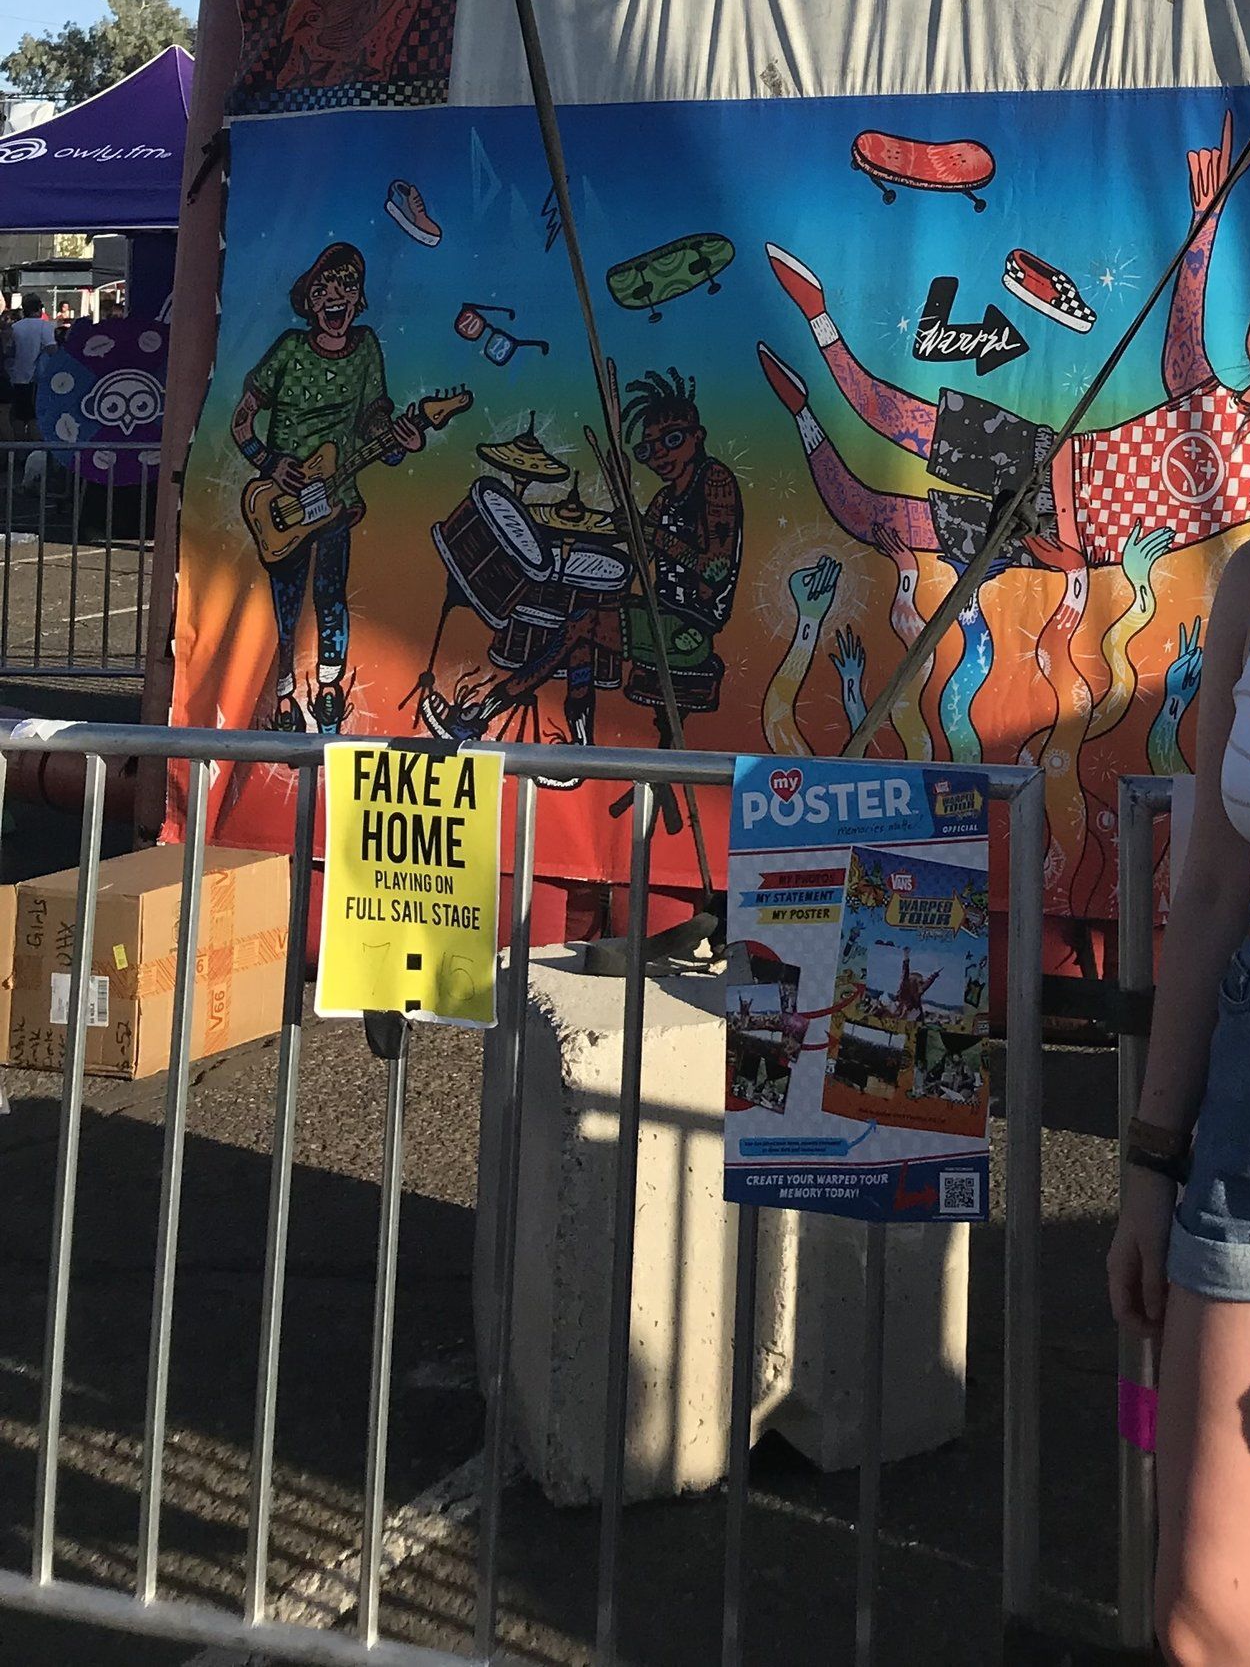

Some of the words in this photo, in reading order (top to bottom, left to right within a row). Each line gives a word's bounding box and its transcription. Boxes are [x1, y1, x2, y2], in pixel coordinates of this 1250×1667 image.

[54, 144, 165, 162] owly.fm
[354, 750, 446, 808] FAKE
[454, 757, 476, 810] A
[773, 775, 798, 791] my
[742, 779, 911, 830] POSTER
[361, 810, 466, 868] HOME
[375, 871, 432, 892] PLAYING
[435, 875, 453, 894] ON
[773, 891, 834, 902] STATEMENT
[346, 897, 385, 921] FULL
[391, 900, 427, 924] SAIL
[432, 904, 480, 930] STAGE
[789, 909, 830, 919] POSTER
[746, 1176, 783, 1185] CREATE
[786, 1175, 814, 1184] YOUR
[817, 1175, 857, 1184] WARPED
[859, 1174, 888, 1184] TOUR
[780, 1189, 823, 1198] MEMORY
